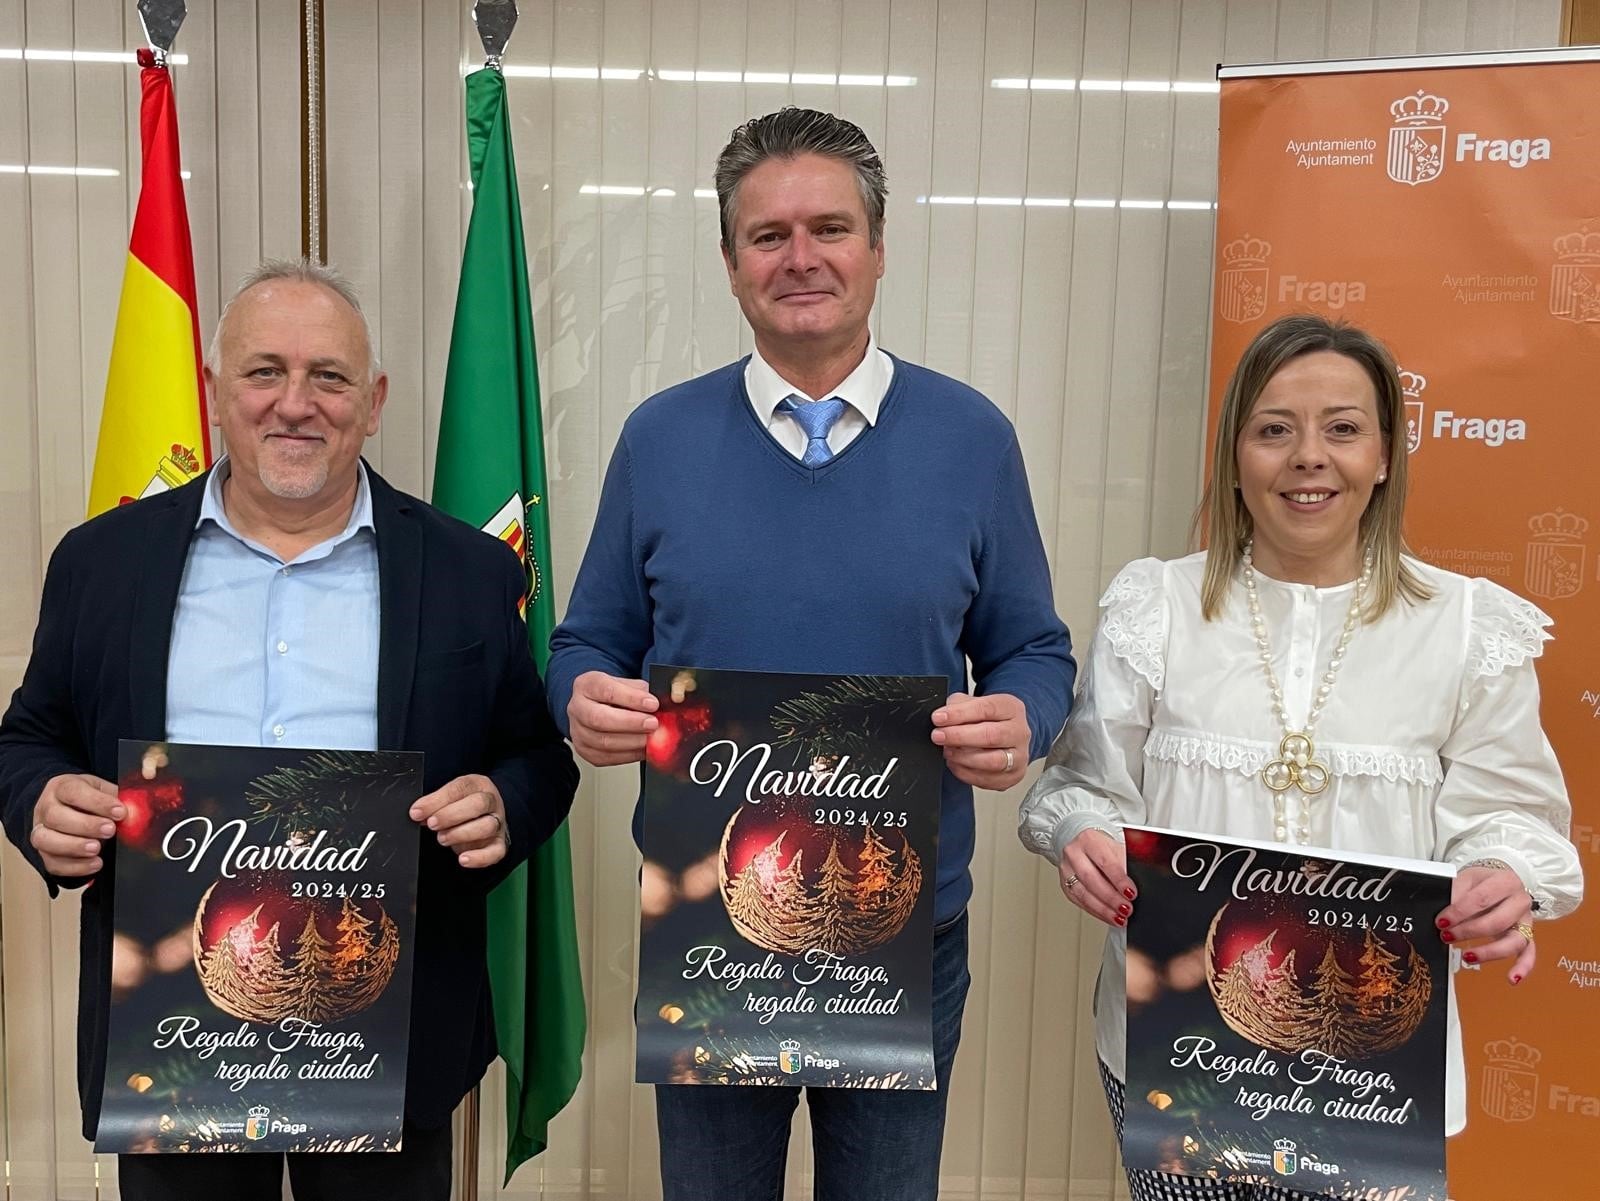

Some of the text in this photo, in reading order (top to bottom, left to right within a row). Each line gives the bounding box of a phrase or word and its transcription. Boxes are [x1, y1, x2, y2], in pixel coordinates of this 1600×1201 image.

[1286, 138, 1376, 155] Ayuntamiento
[1297, 153, 1373, 170] Ajuntament
[1455, 133, 1550, 168] Fraga
[1278, 275, 1366, 309] Fraga
[1441, 273, 1538, 290] Ayuntamiento
[1454, 288, 1535, 304] Ajuntament
[1432, 411, 1526, 447] Fraga
[1420, 545, 1513, 562] Ayuntamiento
[689, 739, 898, 803] Navidad
[814, 808, 907, 828] 2024/25
[161, 815, 378, 878] Navidad
[1171, 843, 1400, 902] Navidad
[291, 881, 386, 899] 2024/25
[1307, 908, 1414, 933] 2024/25
[682, 945, 889, 994] Regala Fraga,
[743, 987, 904, 1025] regala ciudad
[153, 1015, 366, 1059] Regala Fraga,
[214, 1053, 379, 1092] regala ciudad
[804, 1055, 839, 1069] Fraga
[1170, 1035, 1396, 1098] Regala Fraga,
[1234, 1085, 1412, 1125] regala ciudad
[271, 1120, 307, 1134] Fraga
[1300, 1156, 1339, 1175] Fraga
